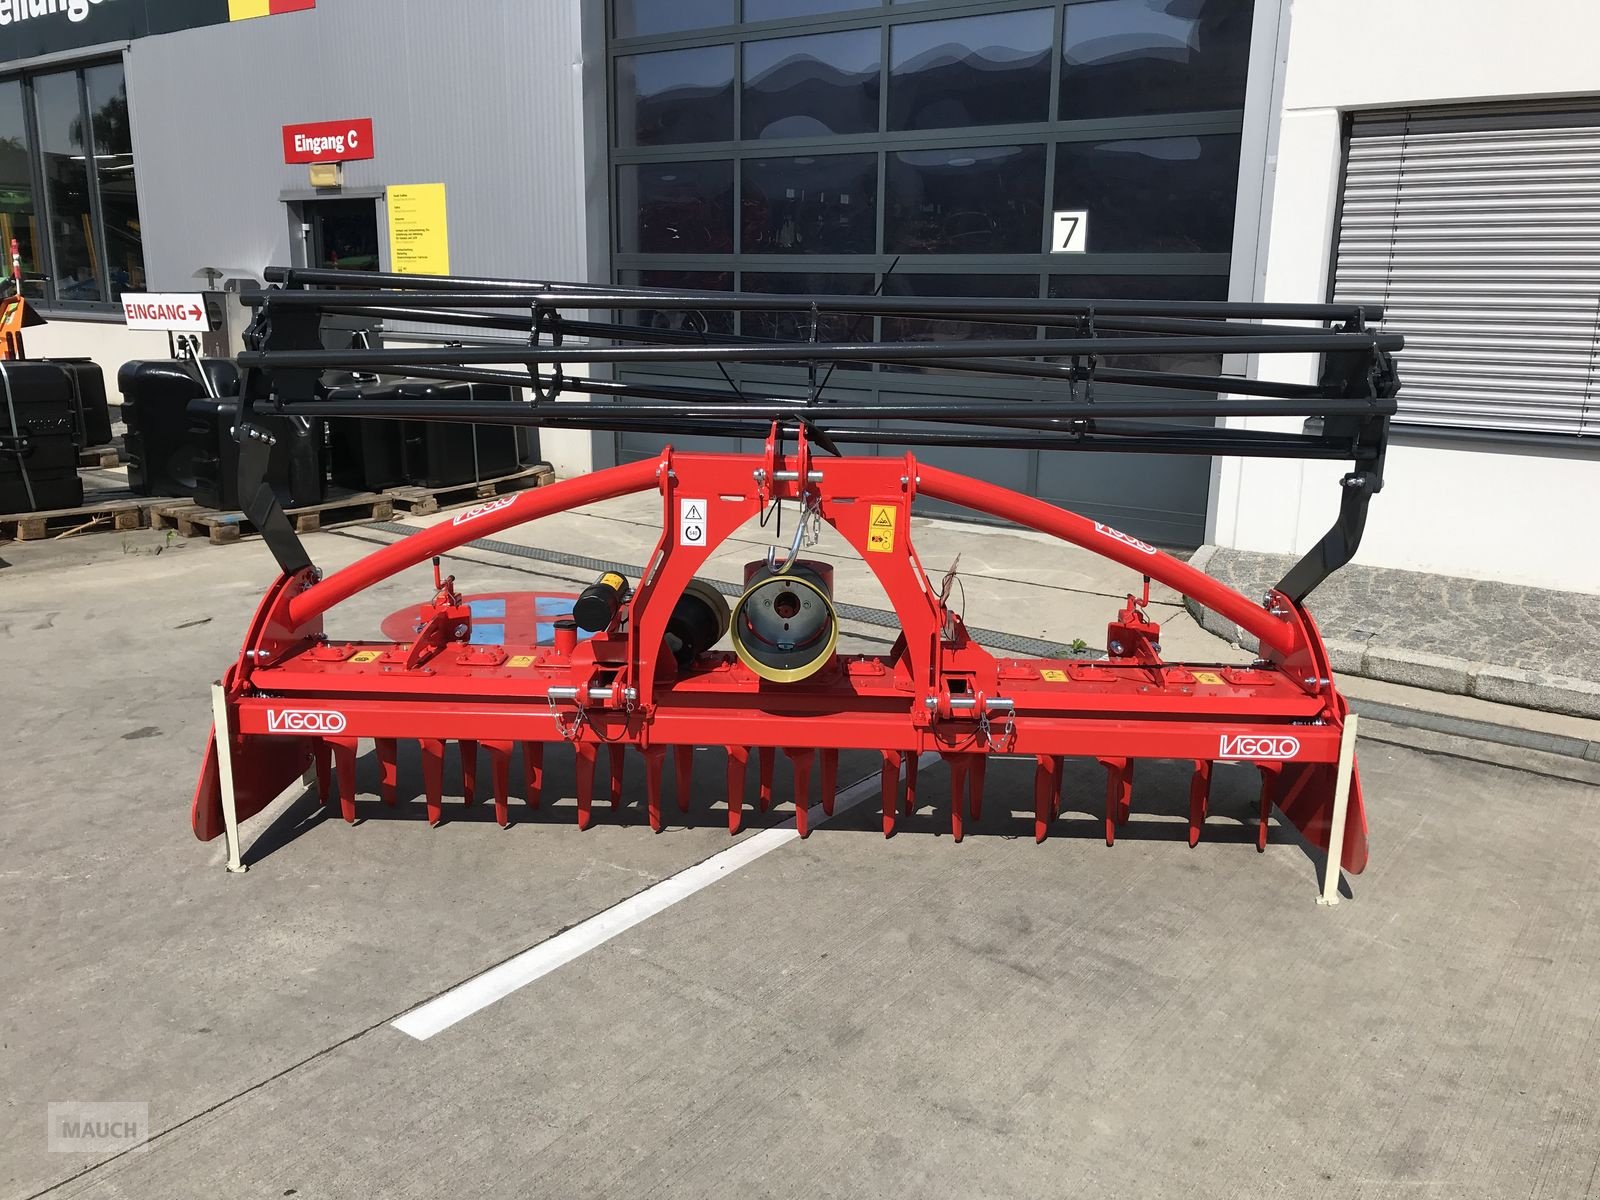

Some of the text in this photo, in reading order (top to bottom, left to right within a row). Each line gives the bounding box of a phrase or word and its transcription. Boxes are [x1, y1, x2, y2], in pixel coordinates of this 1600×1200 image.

[294, 129, 358, 155] Eingang C
[1060, 217, 1079, 248] 7
[125, 303, 187, 320] EINGANG
[267, 709, 346, 733] VIGOLO
[1219, 735, 1300, 758] VIGOLO
